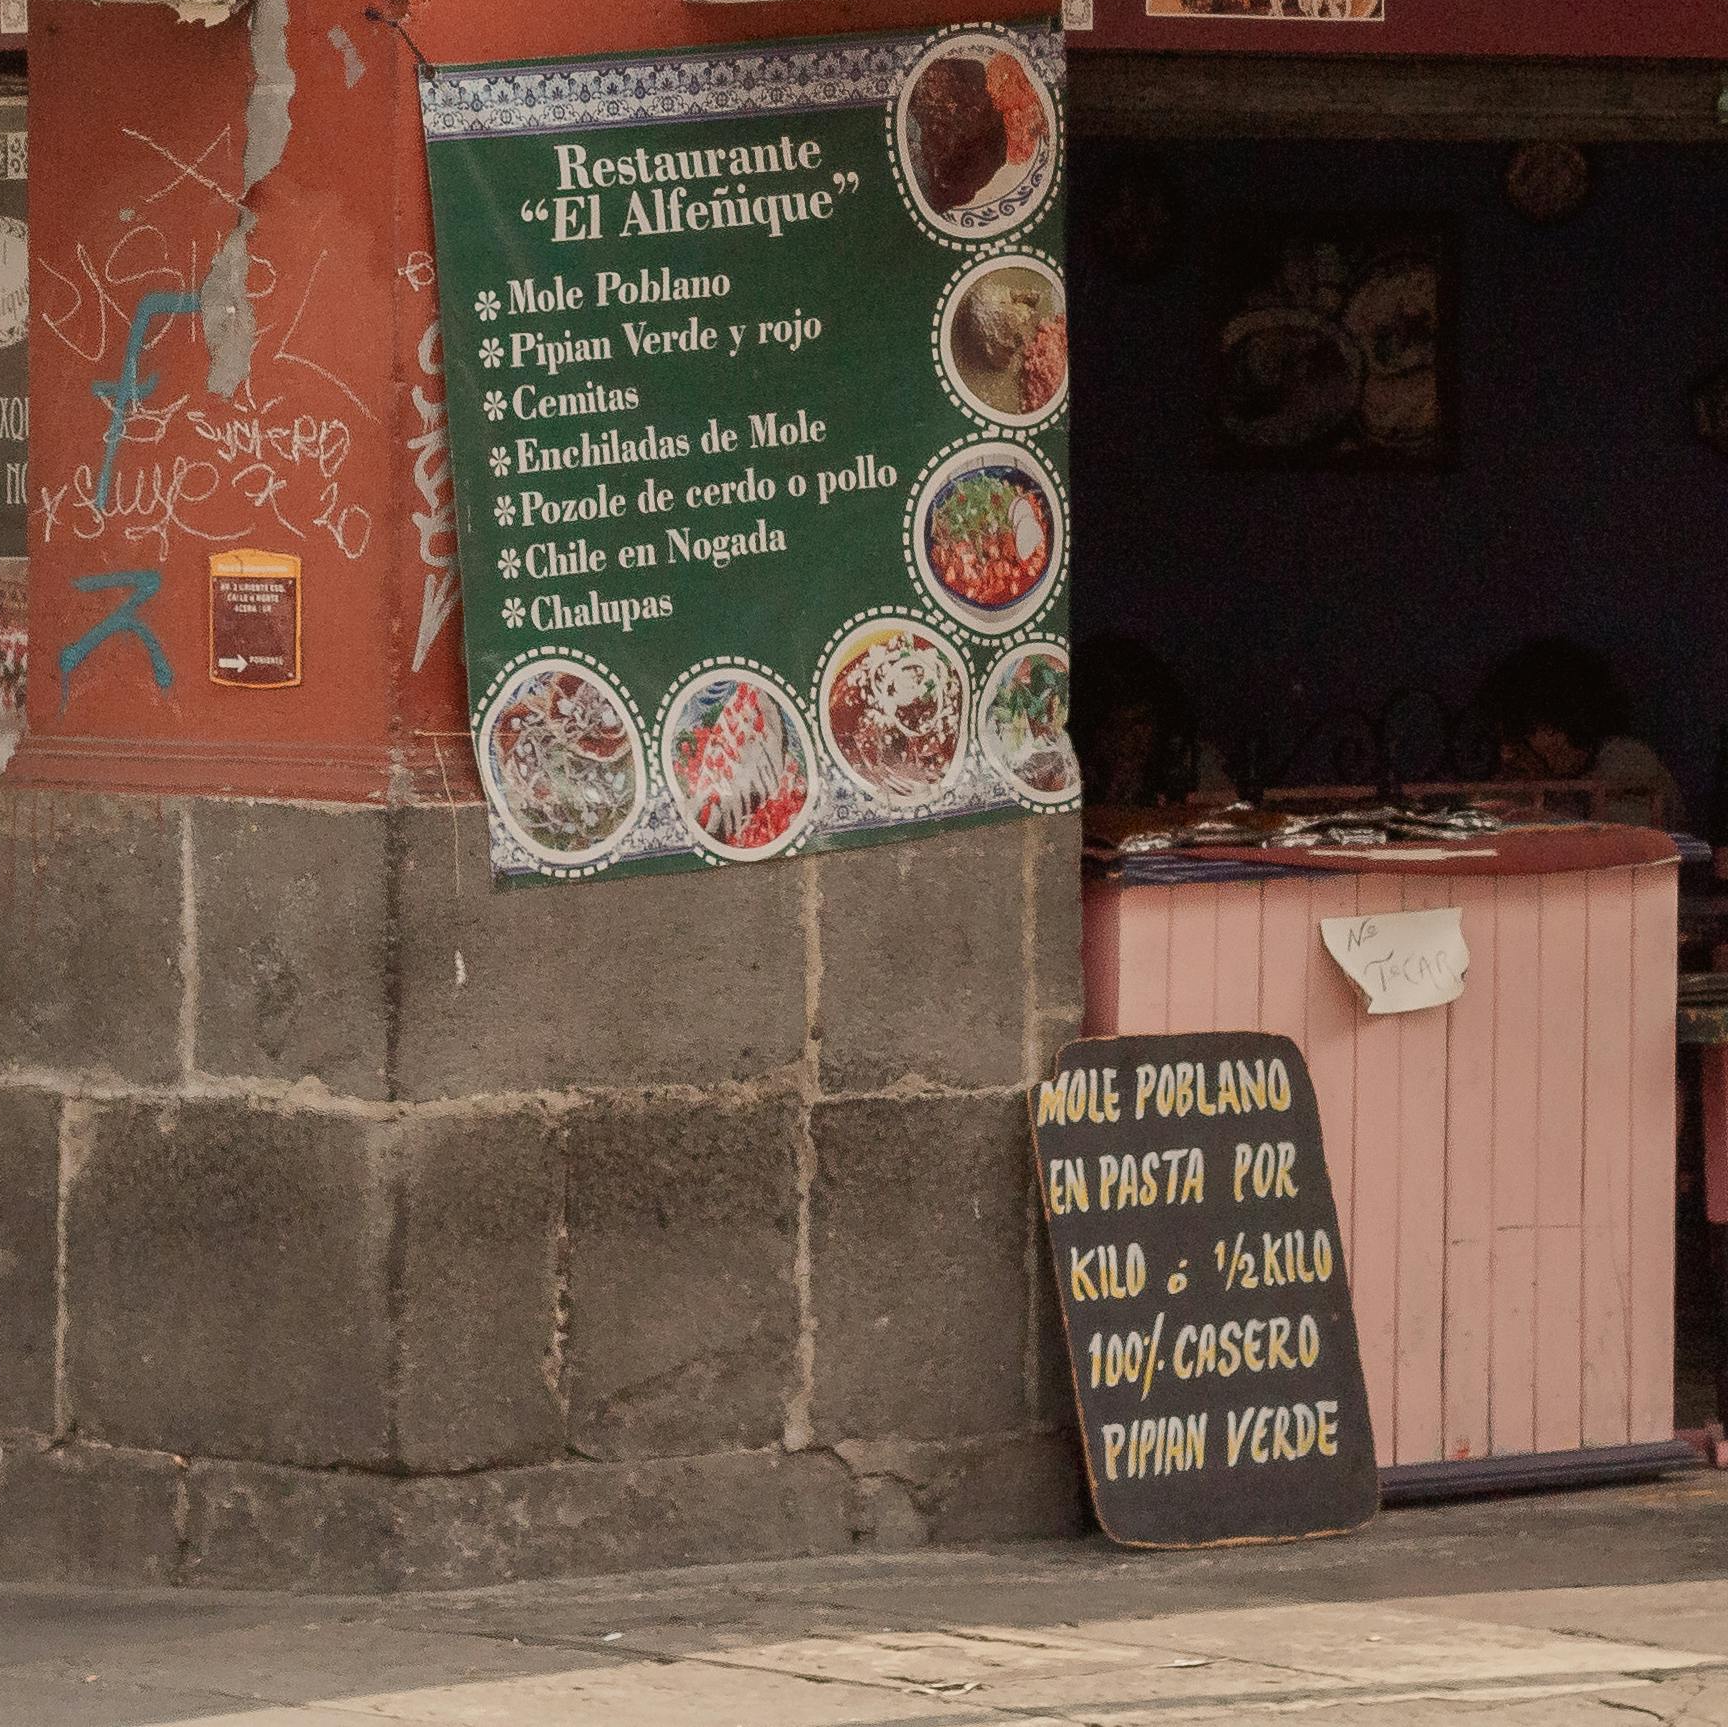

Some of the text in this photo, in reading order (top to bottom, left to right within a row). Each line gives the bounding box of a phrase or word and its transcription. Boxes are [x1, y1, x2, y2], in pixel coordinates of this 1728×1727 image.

[554, 135, 823, 191] Restaurante
[507, 267, 731, 316] Mole Poblano
[509, 309, 822, 375] Pipian Verde y rojo
[511, 381, 640, 421] Cemitas
[516, 410, 827, 475] Enchiladas de Mole
[519, 454, 898, 528] Pozole de cerdo o pollo
[524, 519, 787, 580] Chile en Nogada
[530, 591, 674, 633] Chalupas
[1037, 1057, 1291, 1127] MOLE POBLANO
[1050, 1140, 1299, 1216] EN PASTA POR
[1069, 1243, 1146, 1302] KILO
[1088, 1311, 1321, 1400] 100% CASERO
[1101, 1400, 1339, 1483] PIPIAN VERDE
